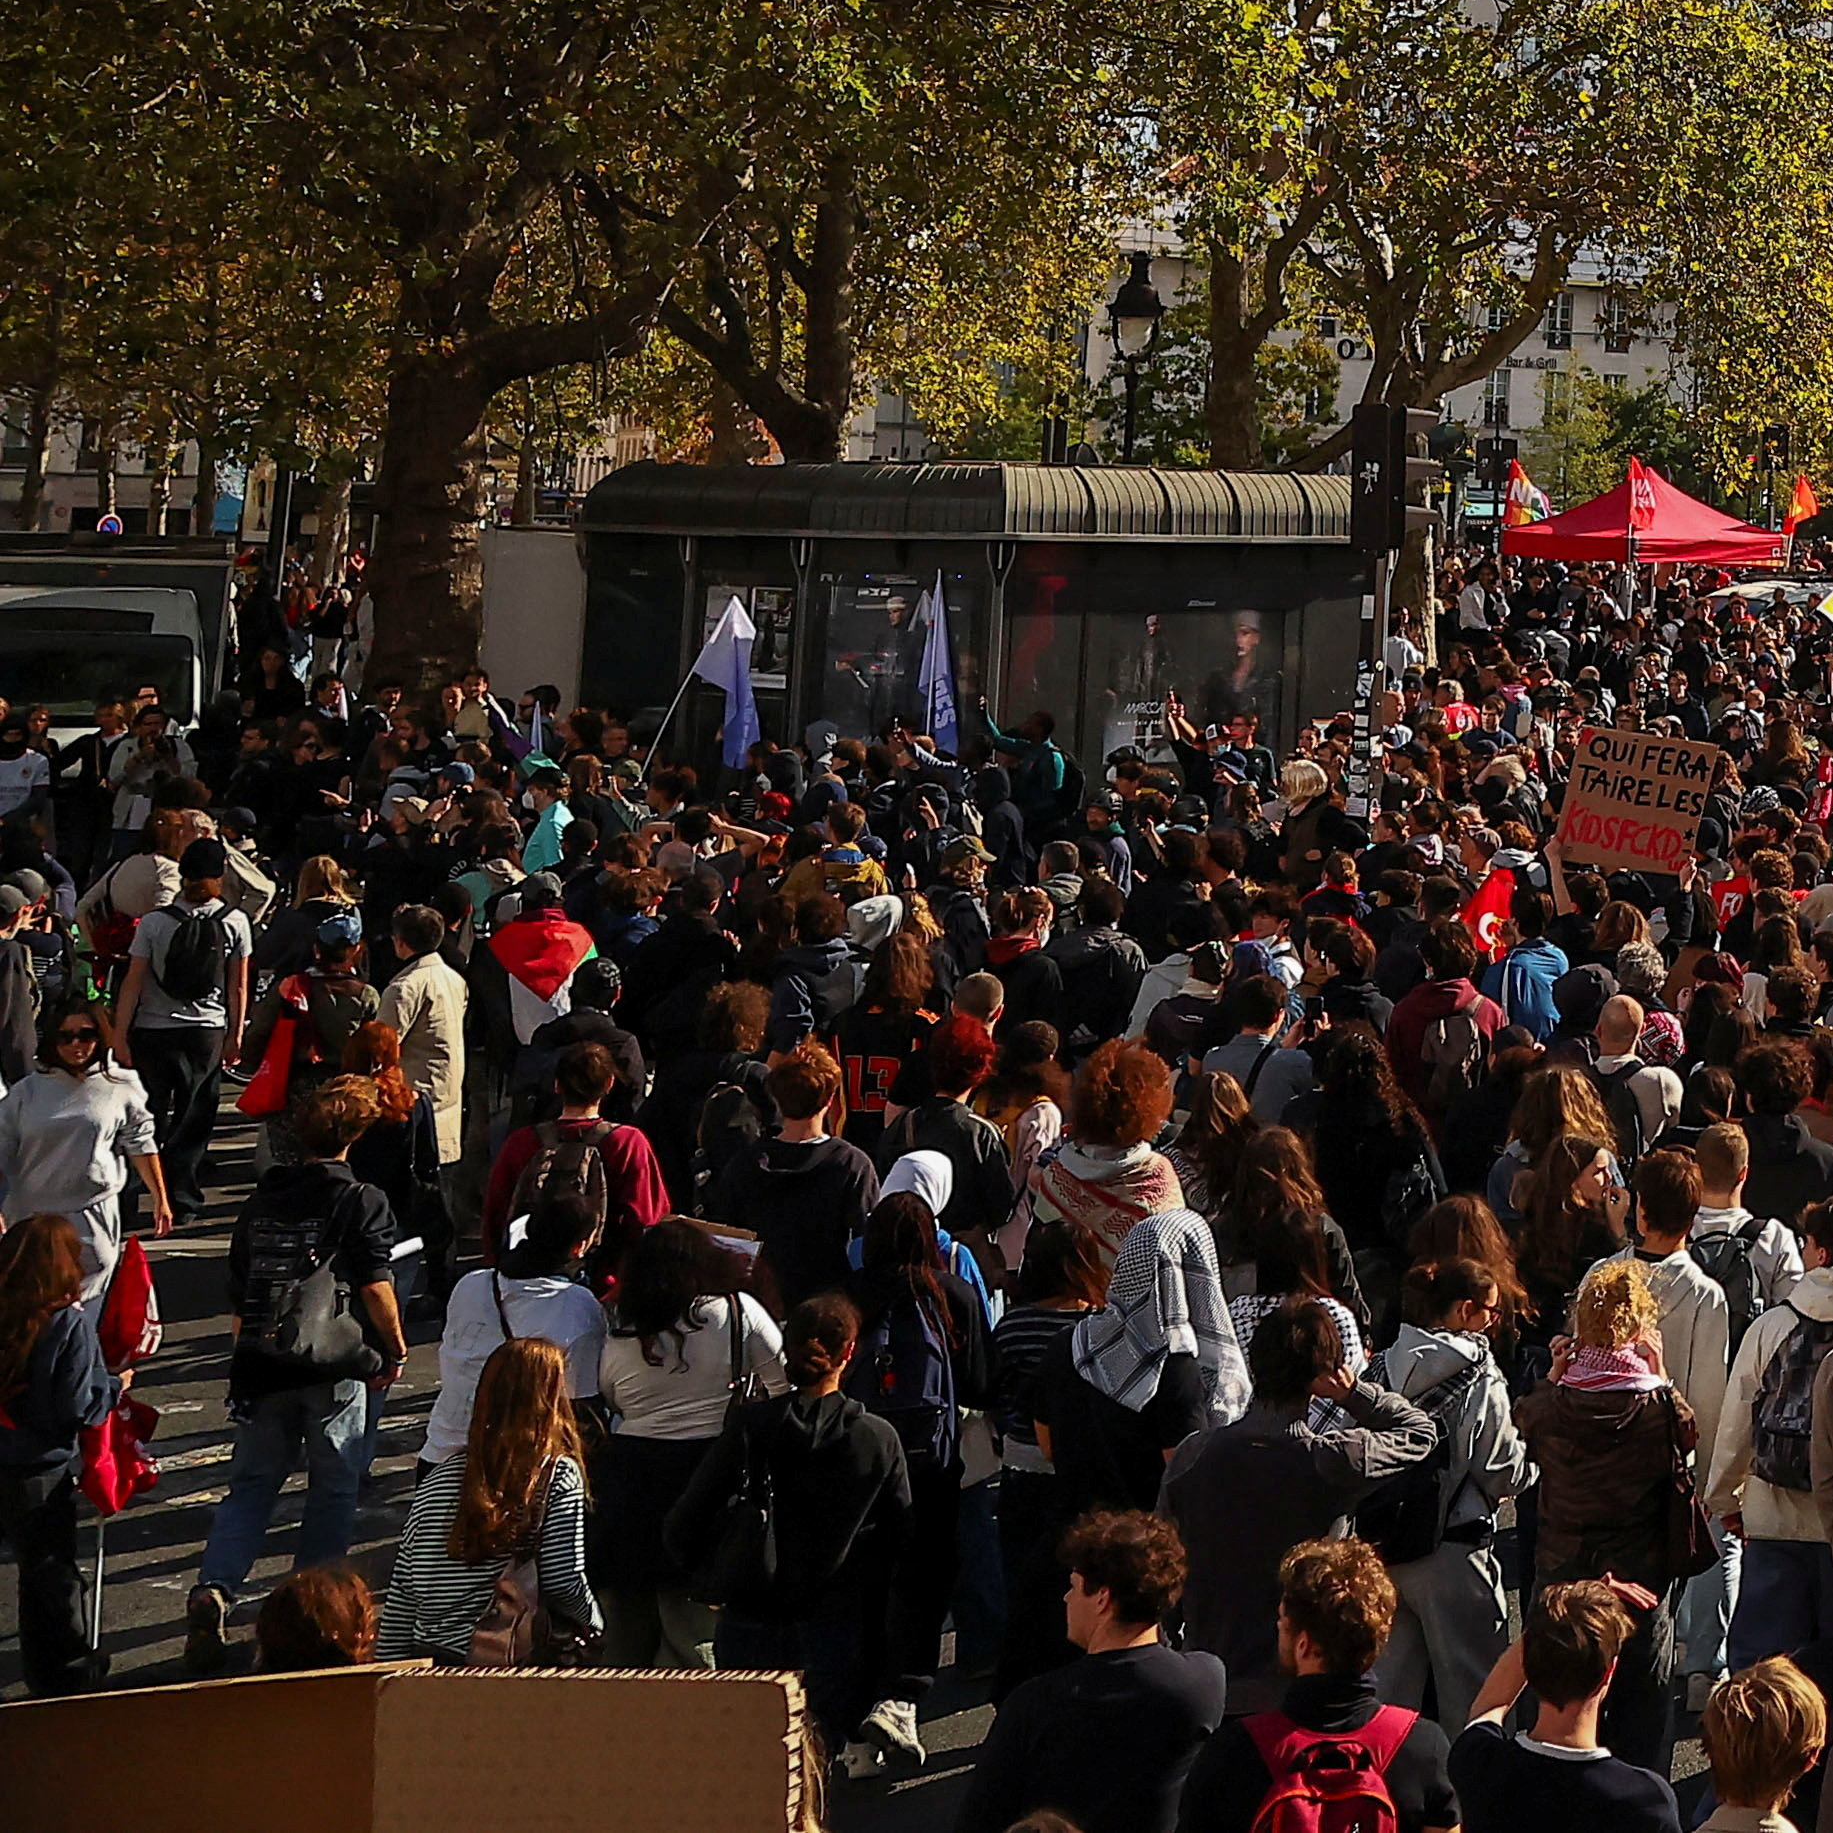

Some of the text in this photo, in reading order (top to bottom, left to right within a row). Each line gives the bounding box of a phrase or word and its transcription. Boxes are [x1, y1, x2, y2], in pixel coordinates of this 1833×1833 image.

[1641, 745, 1711, 783] FERA
[1656, 784, 1705, 817] LES
[1614, 818, 1684, 861] FCKD
[843, 1054, 899, 1112] 13
